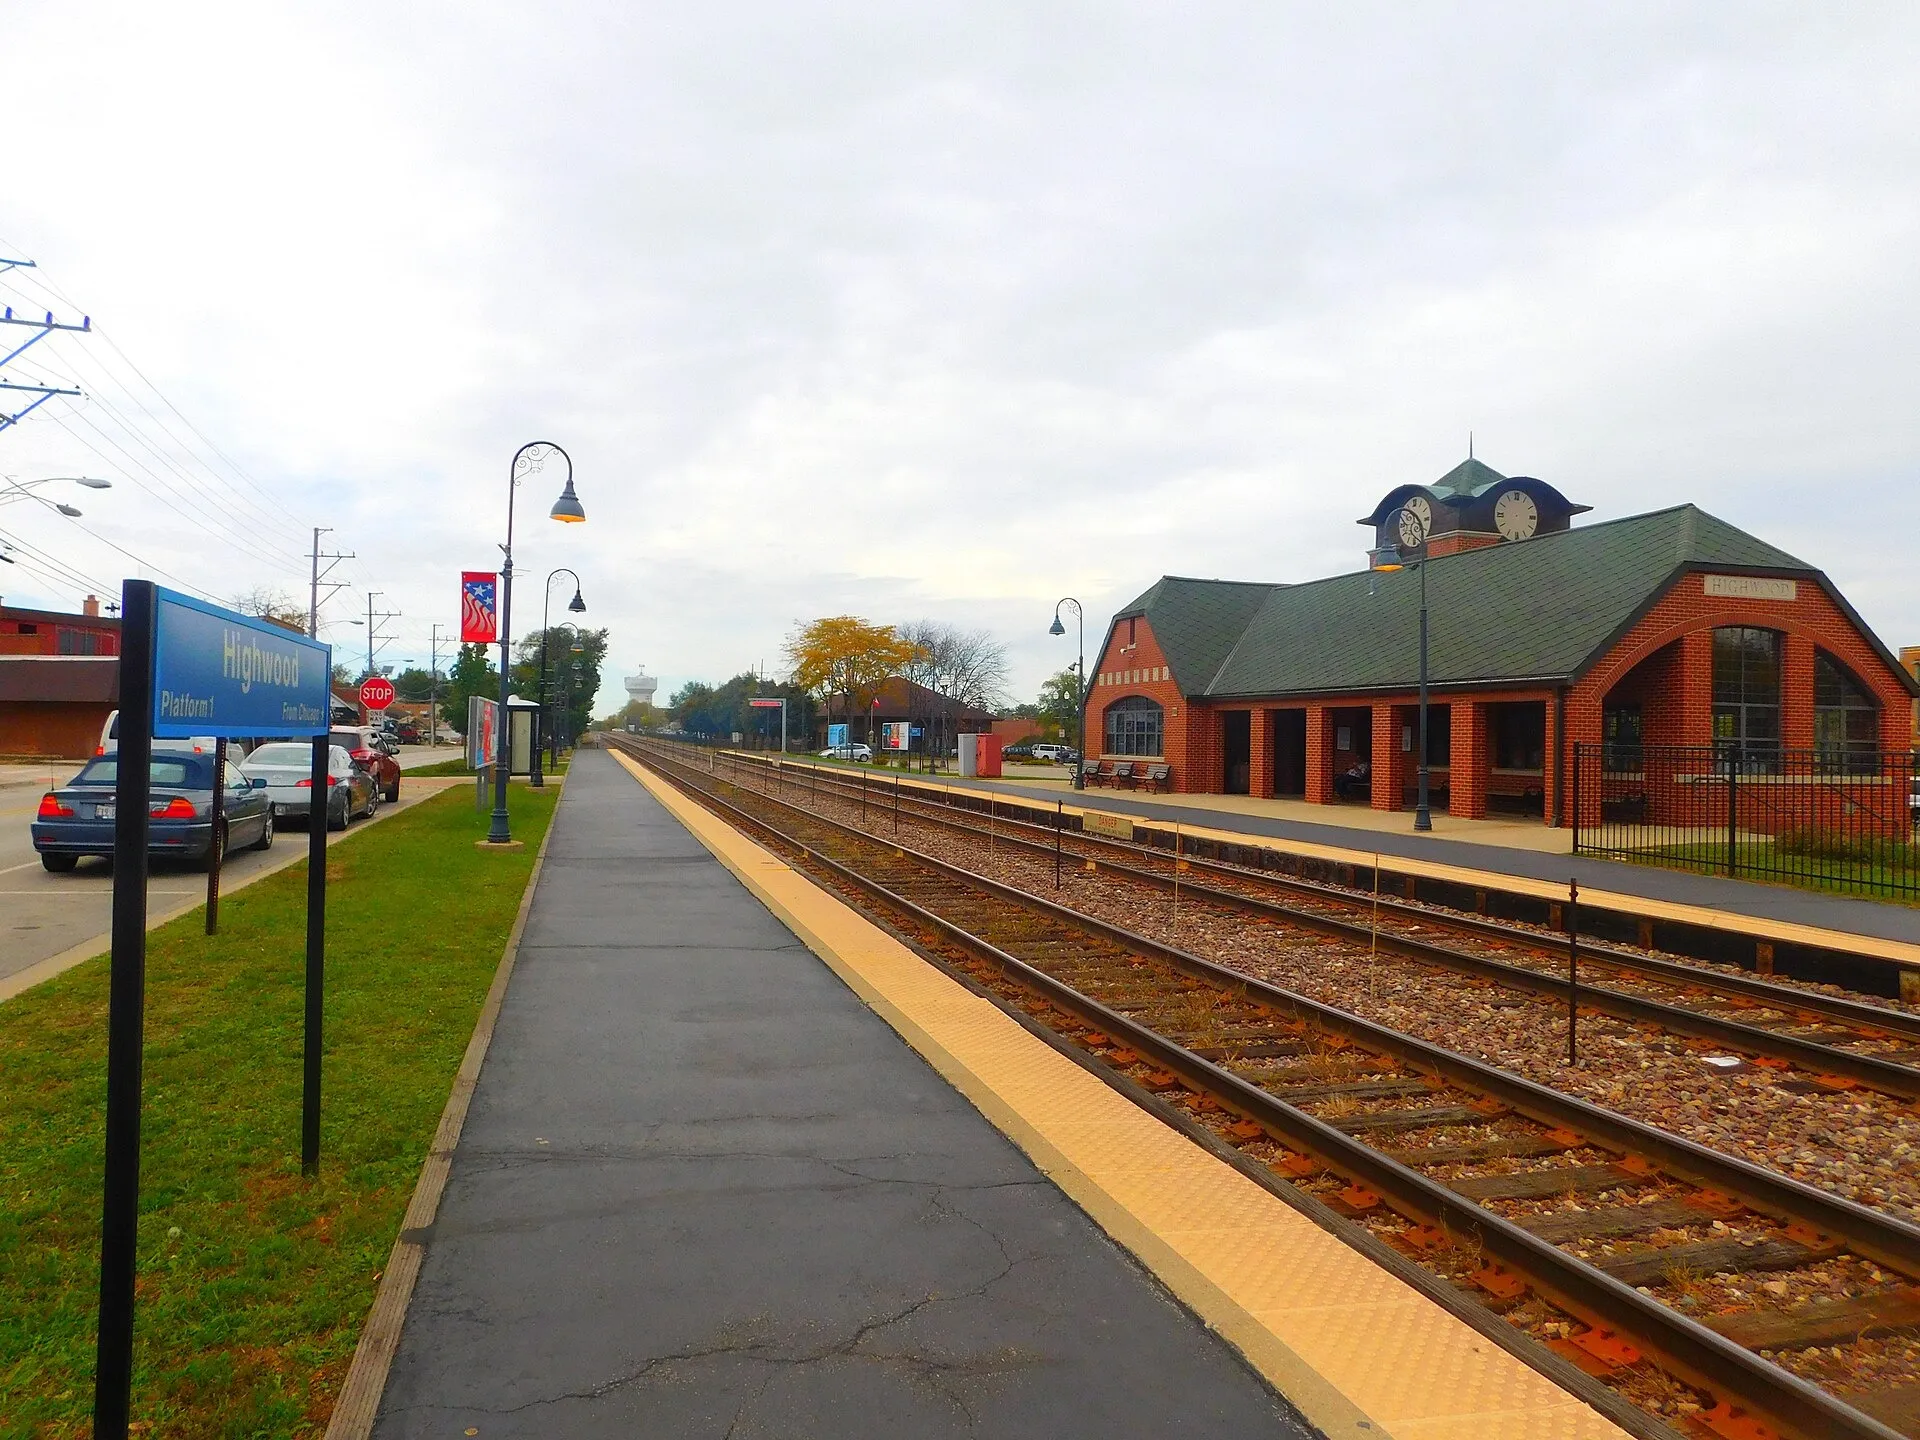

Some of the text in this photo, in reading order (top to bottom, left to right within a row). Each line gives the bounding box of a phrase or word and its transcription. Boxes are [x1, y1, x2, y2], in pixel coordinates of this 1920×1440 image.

[1712, 577, 1789, 596] HIGHWOOD
[224, 628, 299, 694] Highwood
[362, 687, 392, 700] STOP
[161, 690, 208, 718] Platform
[282, 701, 298, 720] From
